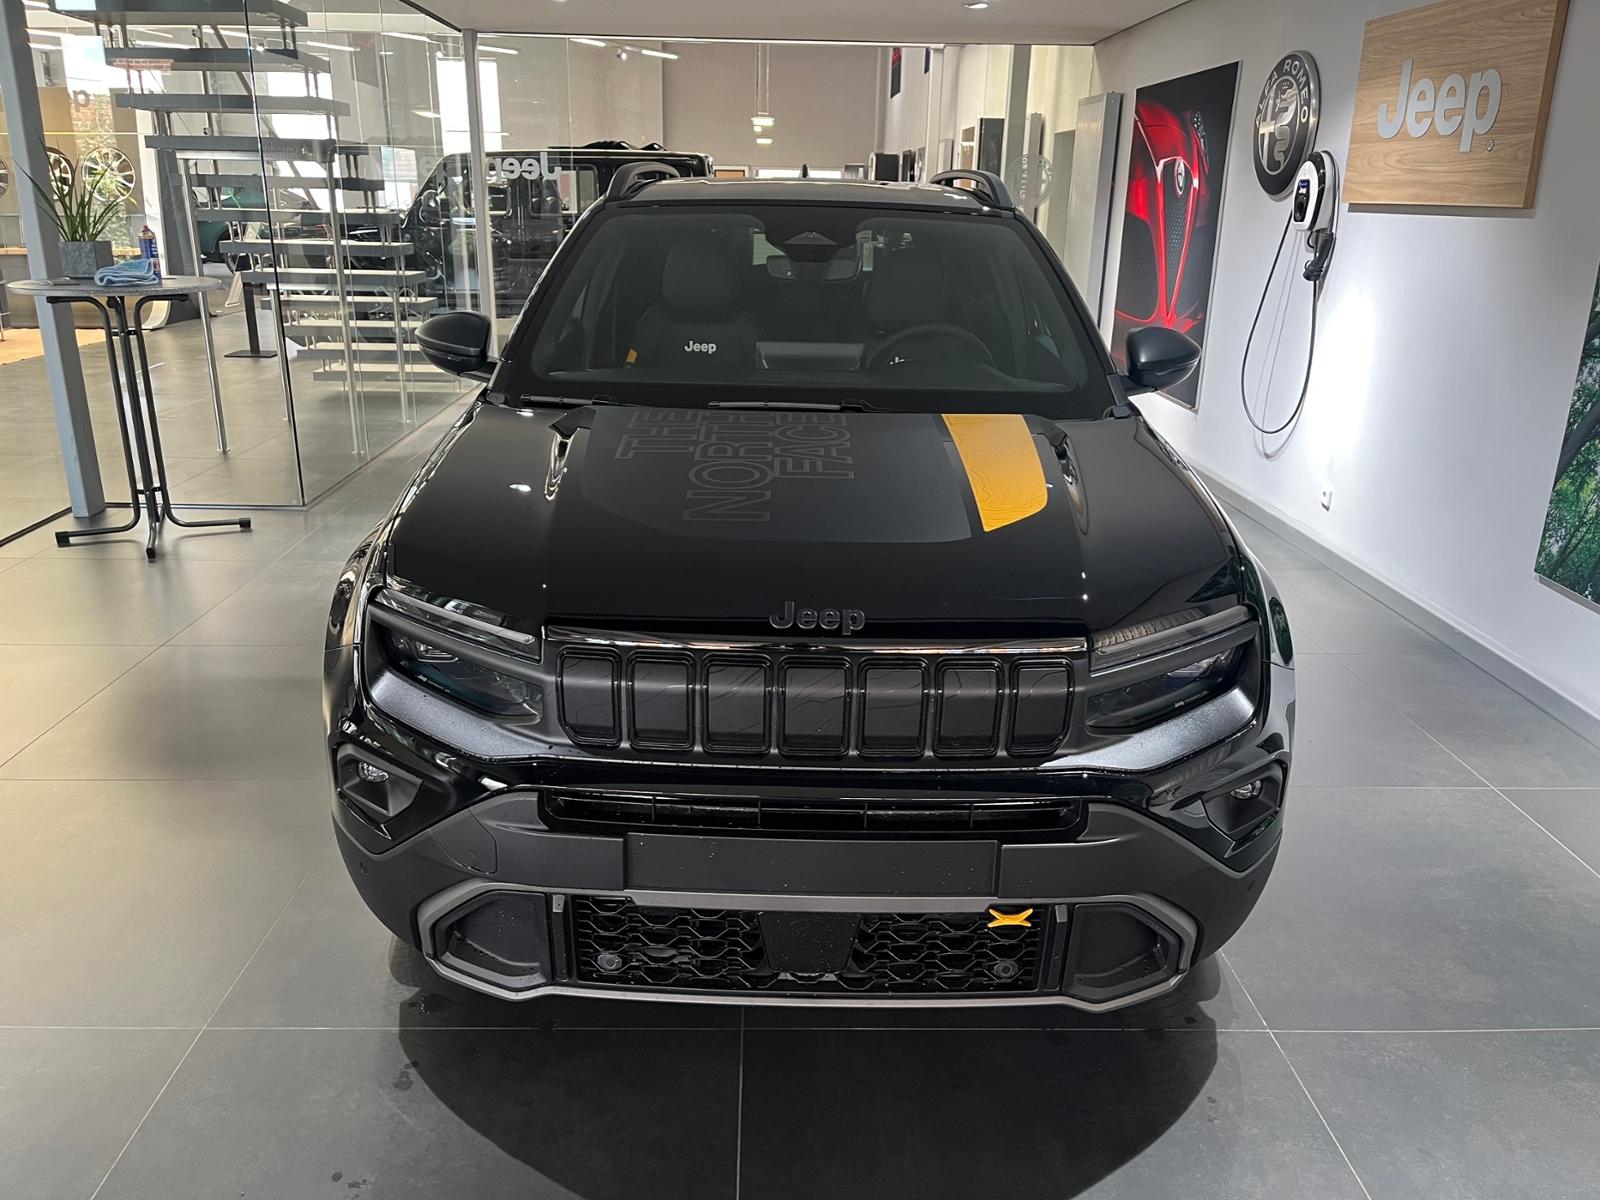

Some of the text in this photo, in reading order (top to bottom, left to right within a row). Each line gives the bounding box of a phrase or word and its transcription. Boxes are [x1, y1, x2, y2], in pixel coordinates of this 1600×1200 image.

[1255, 58, 1309, 129] ALFA ROMEO
[1376, 57, 1502, 153] Jeep
[684, 340, 717, 355] Jeep
[614, 408, 704, 460] THE
[772, 411, 855, 480] FACE
[769, 600, 866, 635] Jeep
